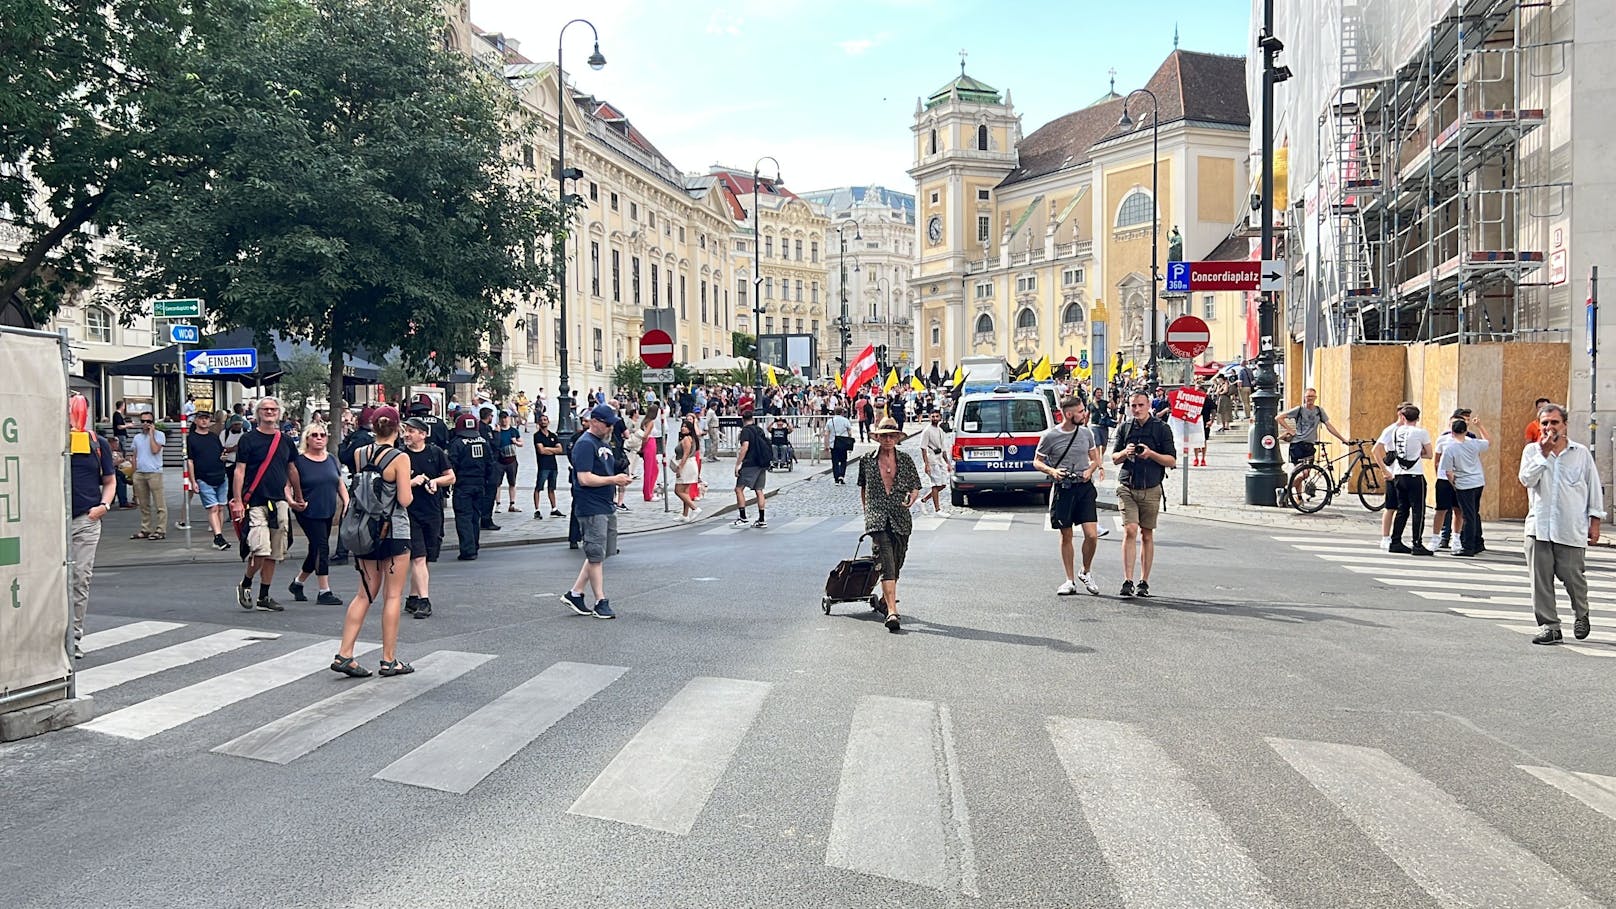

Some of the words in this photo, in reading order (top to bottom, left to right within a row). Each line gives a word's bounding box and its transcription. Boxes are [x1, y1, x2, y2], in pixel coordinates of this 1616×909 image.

[1191, 271, 1259, 284] Concordiaplatz
[1169, 281, 1187, 290] 360m
[208, 356, 248, 367] EINBAHN
[1174, 400, 1203, 415] Zeitung
